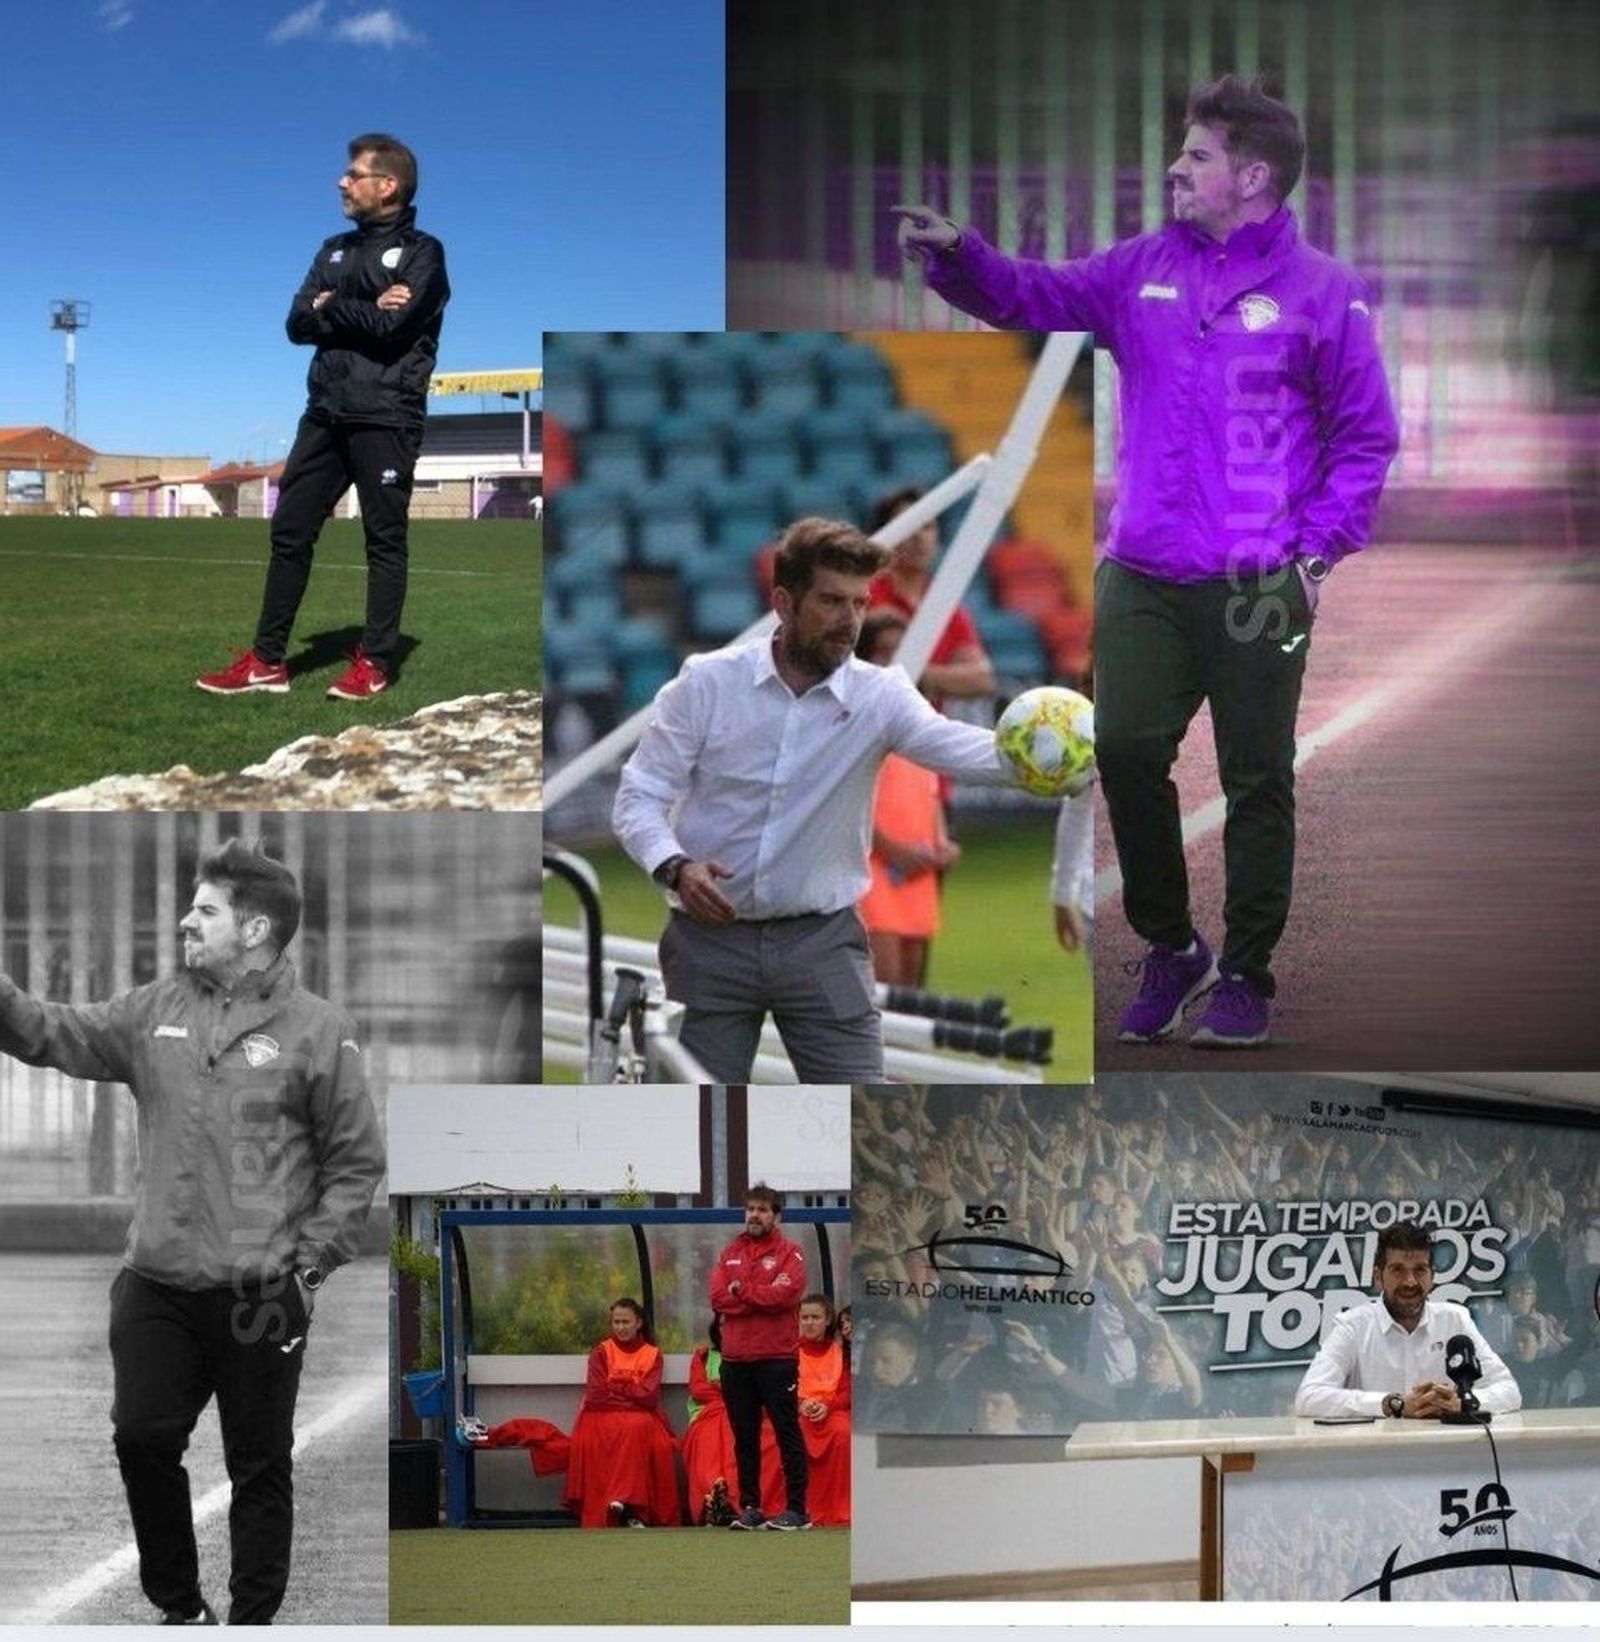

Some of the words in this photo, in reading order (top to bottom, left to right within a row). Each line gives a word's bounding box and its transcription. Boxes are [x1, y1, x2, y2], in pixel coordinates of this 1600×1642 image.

[1169, 1202, 1268, 1234] ESTA
[1277, 1199, 1492, 1232] TEMPORADA
[1156, 1227, 1508, 1296] JUGAOS
[1439, 1483, 1511, 1537] 50
